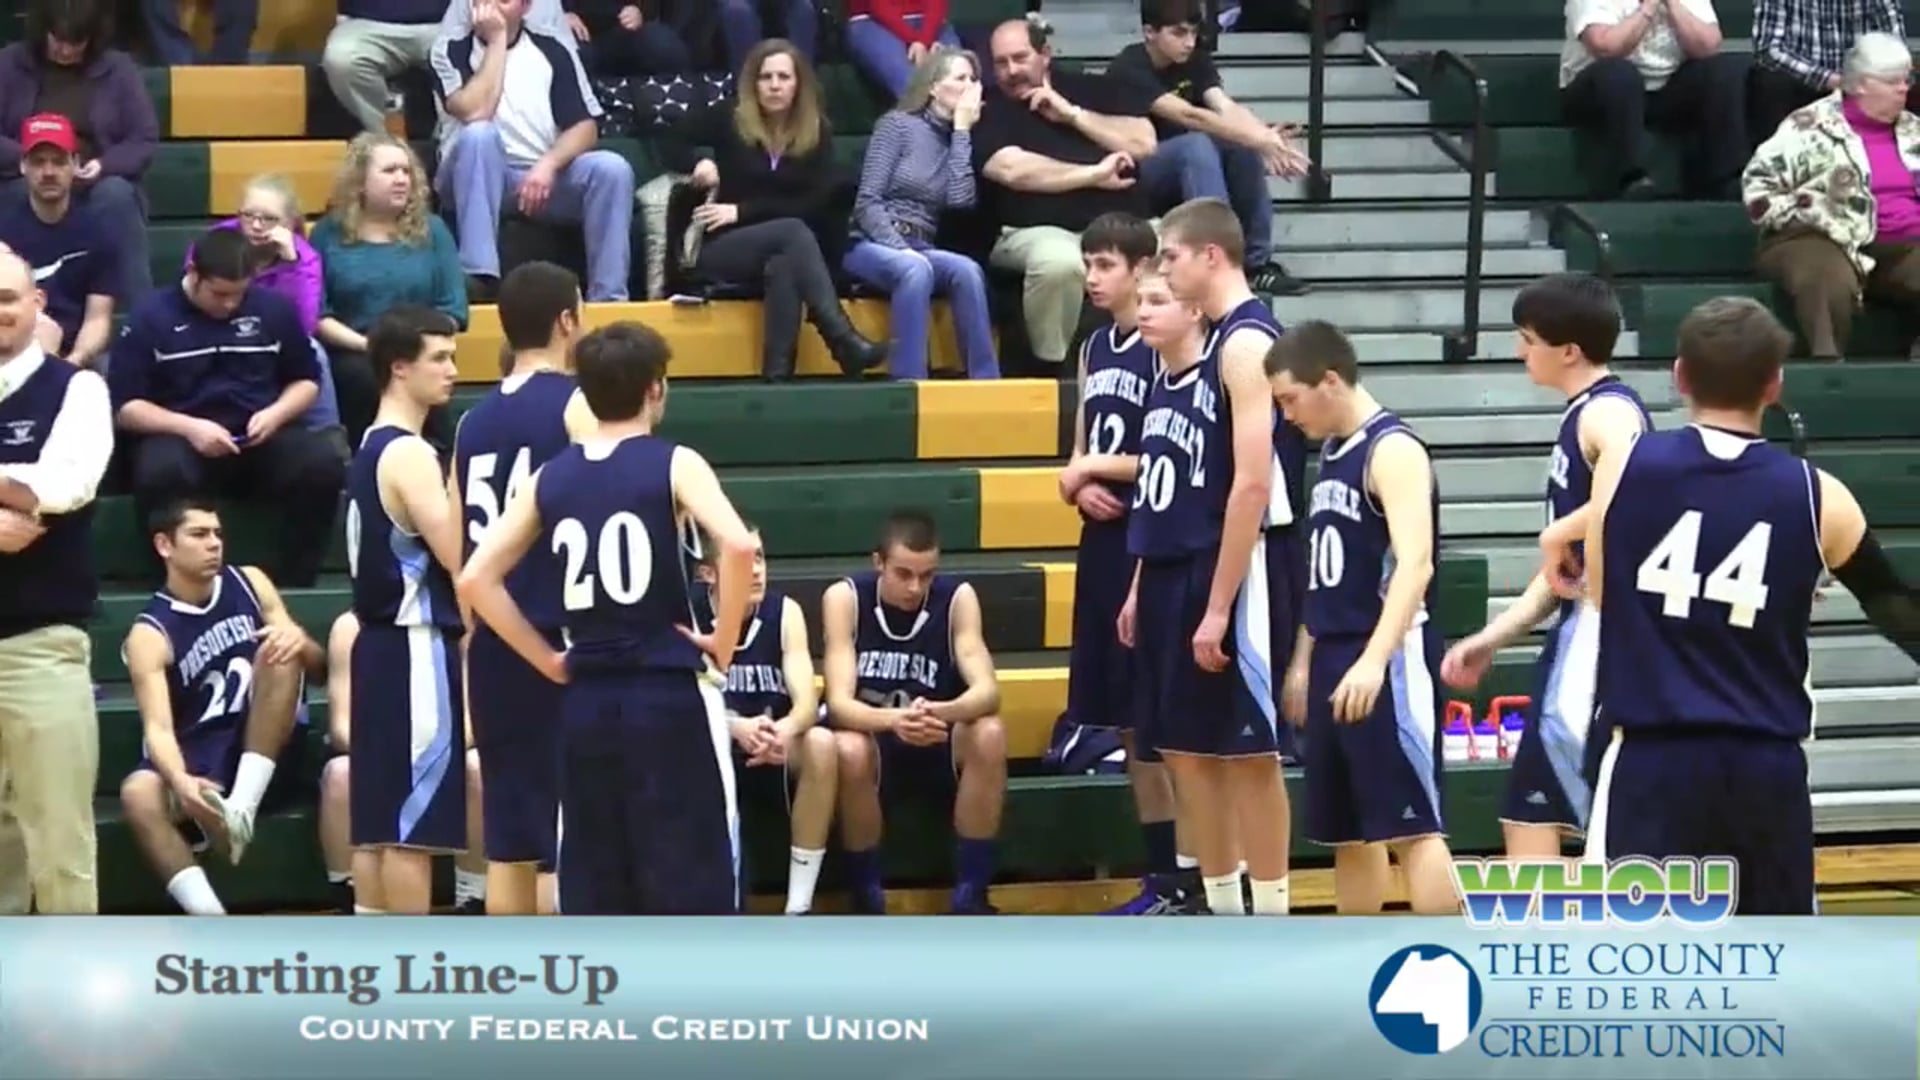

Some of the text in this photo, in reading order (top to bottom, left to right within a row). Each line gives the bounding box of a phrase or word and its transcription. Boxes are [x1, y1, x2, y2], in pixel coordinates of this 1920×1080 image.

[1132, 453, 1176, 512] 30
[551, 511, 652, 611] 20
[1307, 525, 1345, 590] 10
[1636, 509, 1772, 629] 44
[179, 620, 235, 687] PRESQUE
[858, 651, 939, 690] RESQUE SLE
